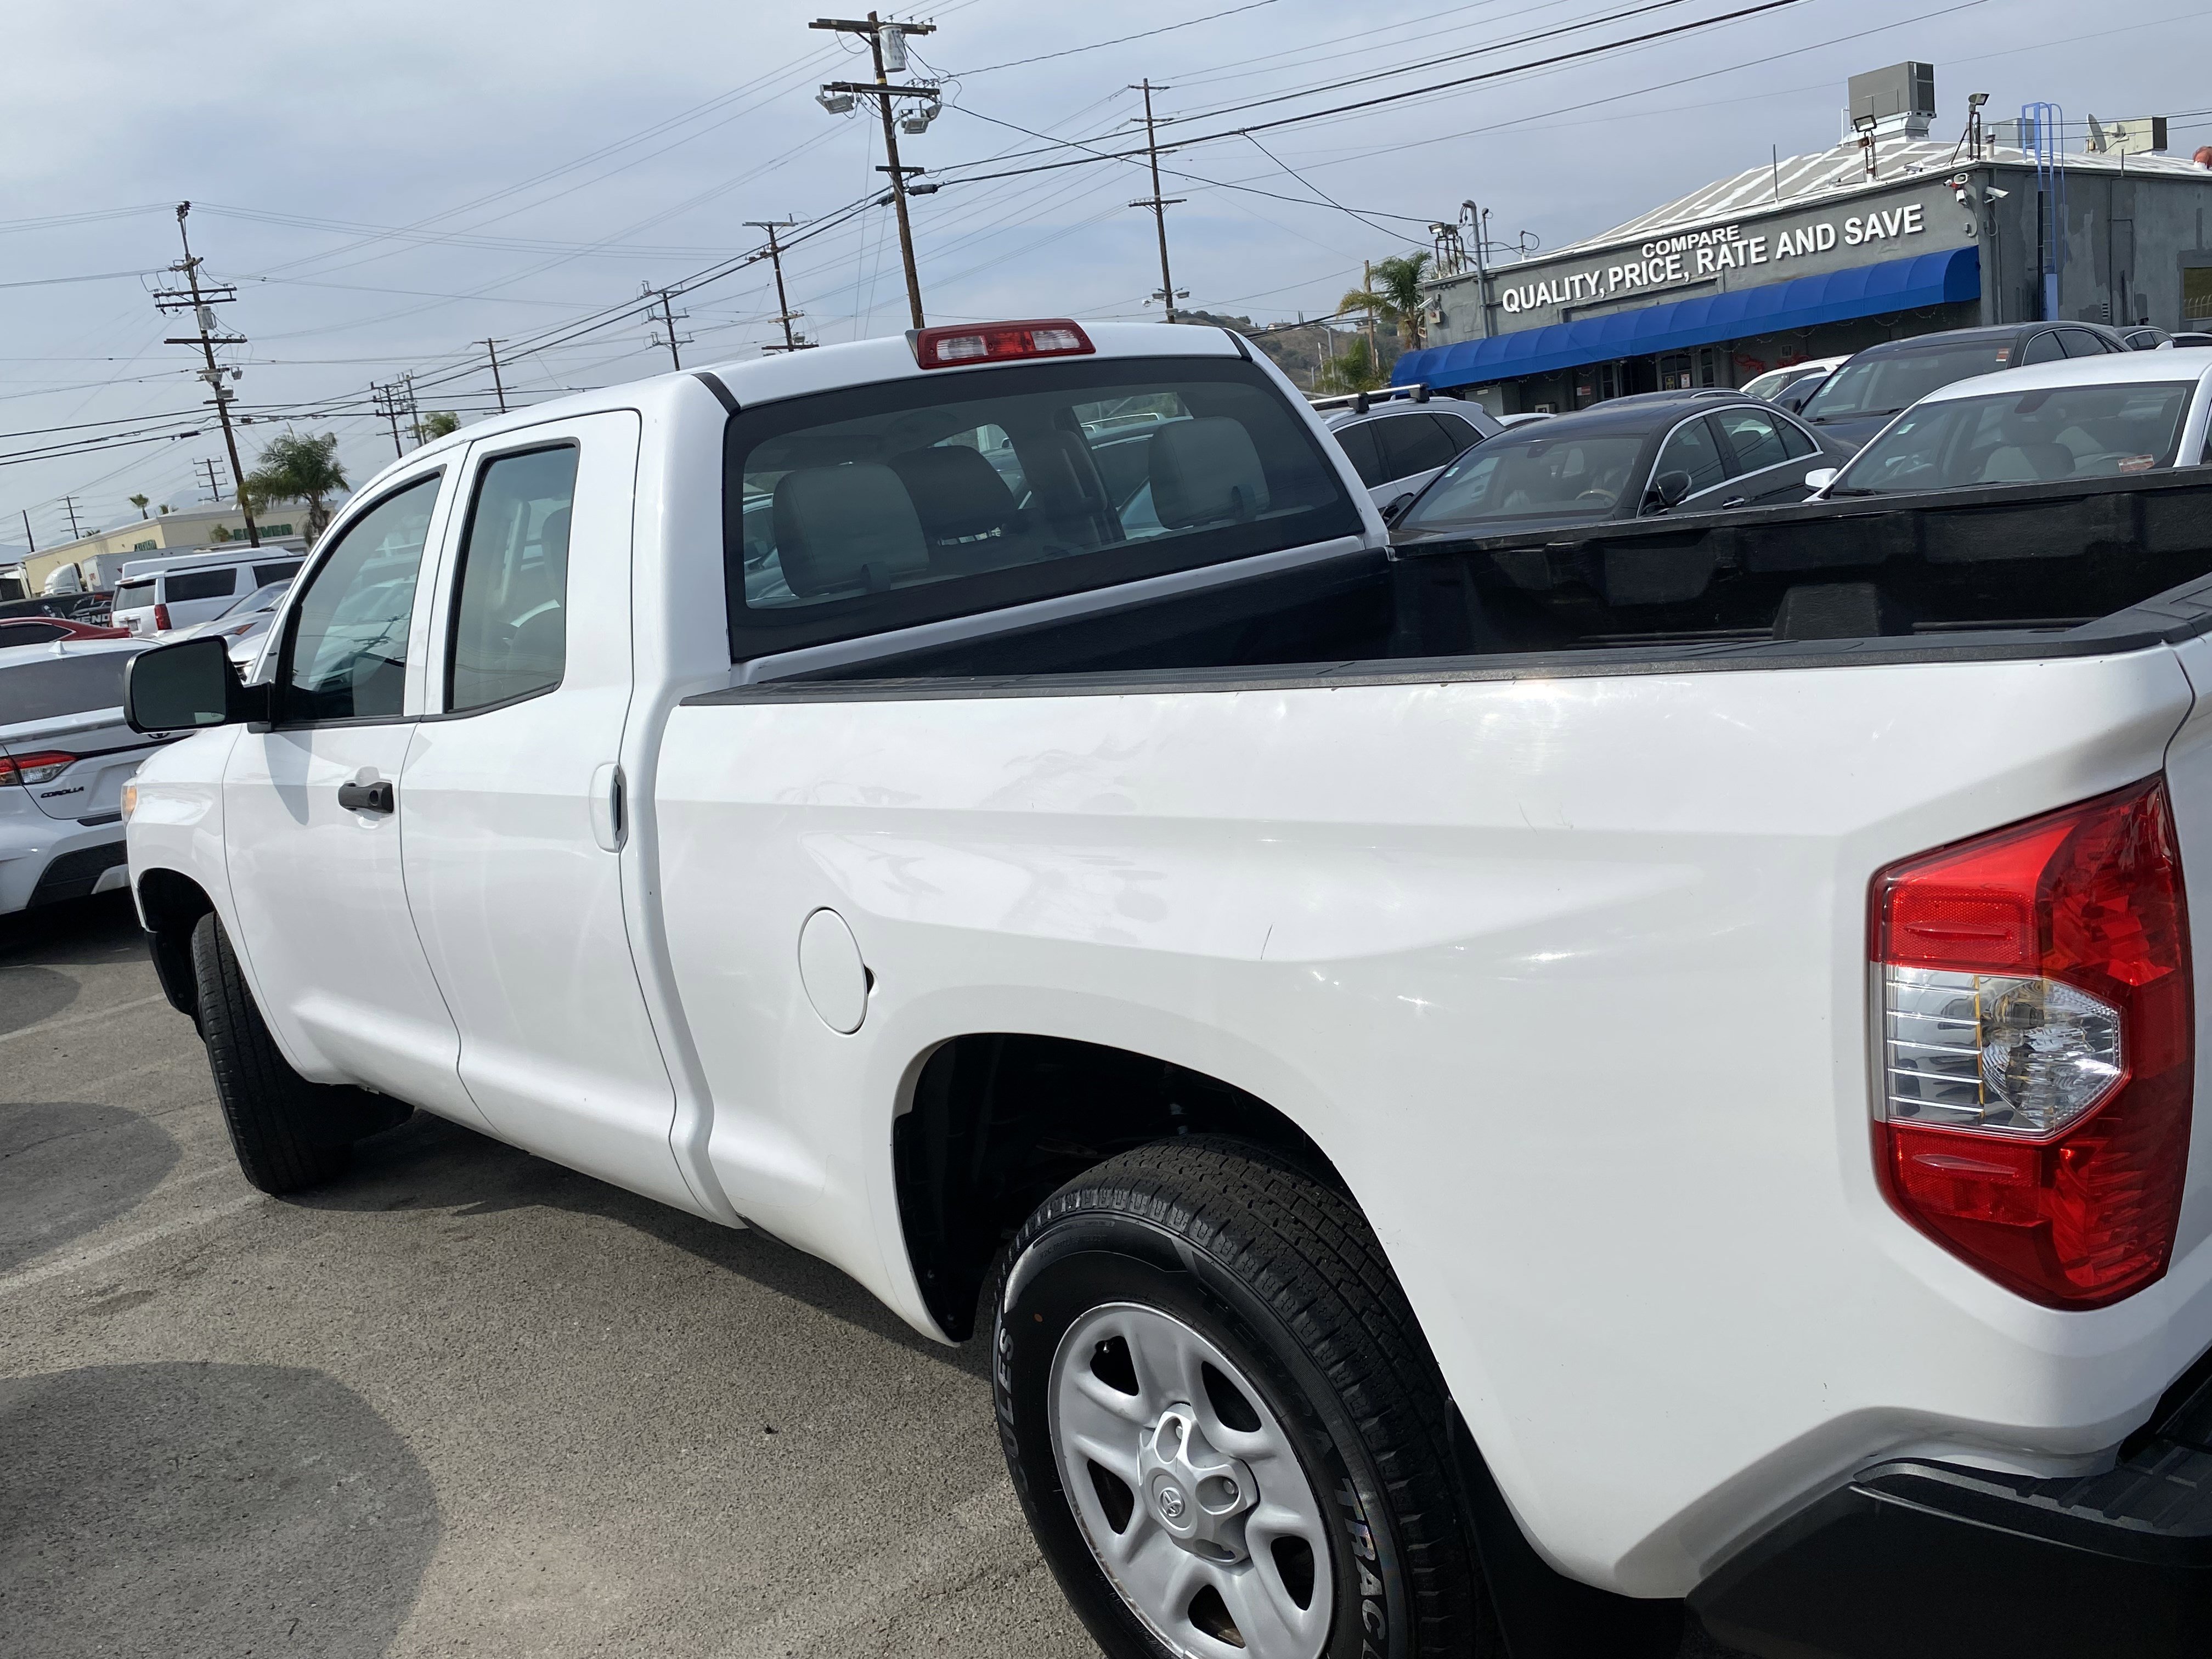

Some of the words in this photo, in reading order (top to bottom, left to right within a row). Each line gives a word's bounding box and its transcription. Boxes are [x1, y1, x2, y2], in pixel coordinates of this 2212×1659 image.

[1502, 269, 1605, 313] QUALITY,
[1608, 253, 1690, 292] PRICE,
[1696, 235, 1768, 274] RATE
[1775, 223, 1836, 259] AND
[1844, 203, 1923, 245] SAVE
[1641, 224, 1740, 258] COMPARE
[1333, 1477, 1387, 1640] TRAC
